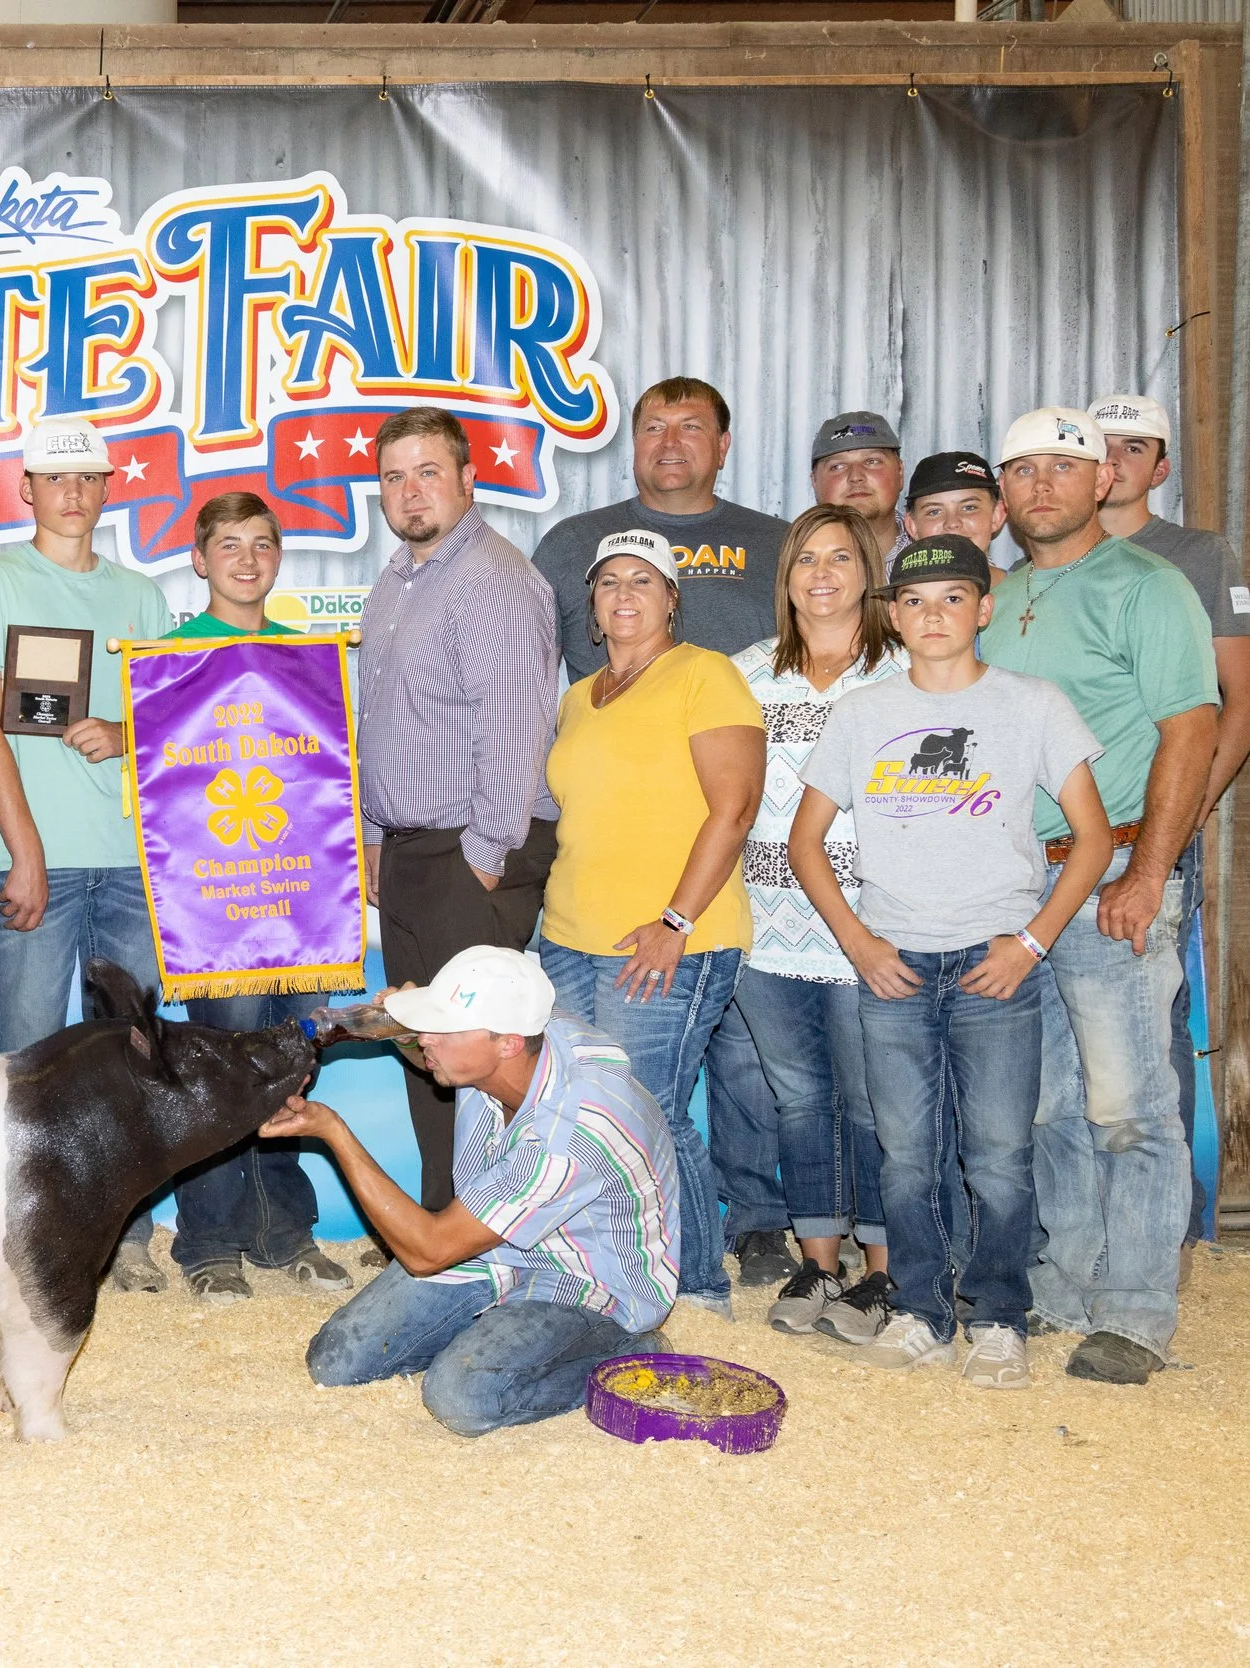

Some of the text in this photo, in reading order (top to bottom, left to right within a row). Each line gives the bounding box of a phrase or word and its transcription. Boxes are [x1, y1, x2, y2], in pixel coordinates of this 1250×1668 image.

[151, 189, 600, 446] FAIR
[608, 535, 628, 548] TEAM
[630, 535, 655, 549] SLOAN
[672, 544, 746, 570] OAN
[902, 549, 955, 565] MILLER BROS.
[688, 568, 742, 577] HAPPEN.
[310, 595, 367, 614] Dako
[213, 702, 264, 728] 2022
[163, 732, 321, 767] South Dakota
[864, 760, 991, 796] Sweet
[865, 795, 956, 804] COUNTY SHOWDOWN
[895, 805, 913, 813] 2022
[948, 789, 1001, 817] 16
[193, 853, 312, 878] Champion
[200, 878, 310, 900] Market Swine
[225, 899, 291, 921] Overall
